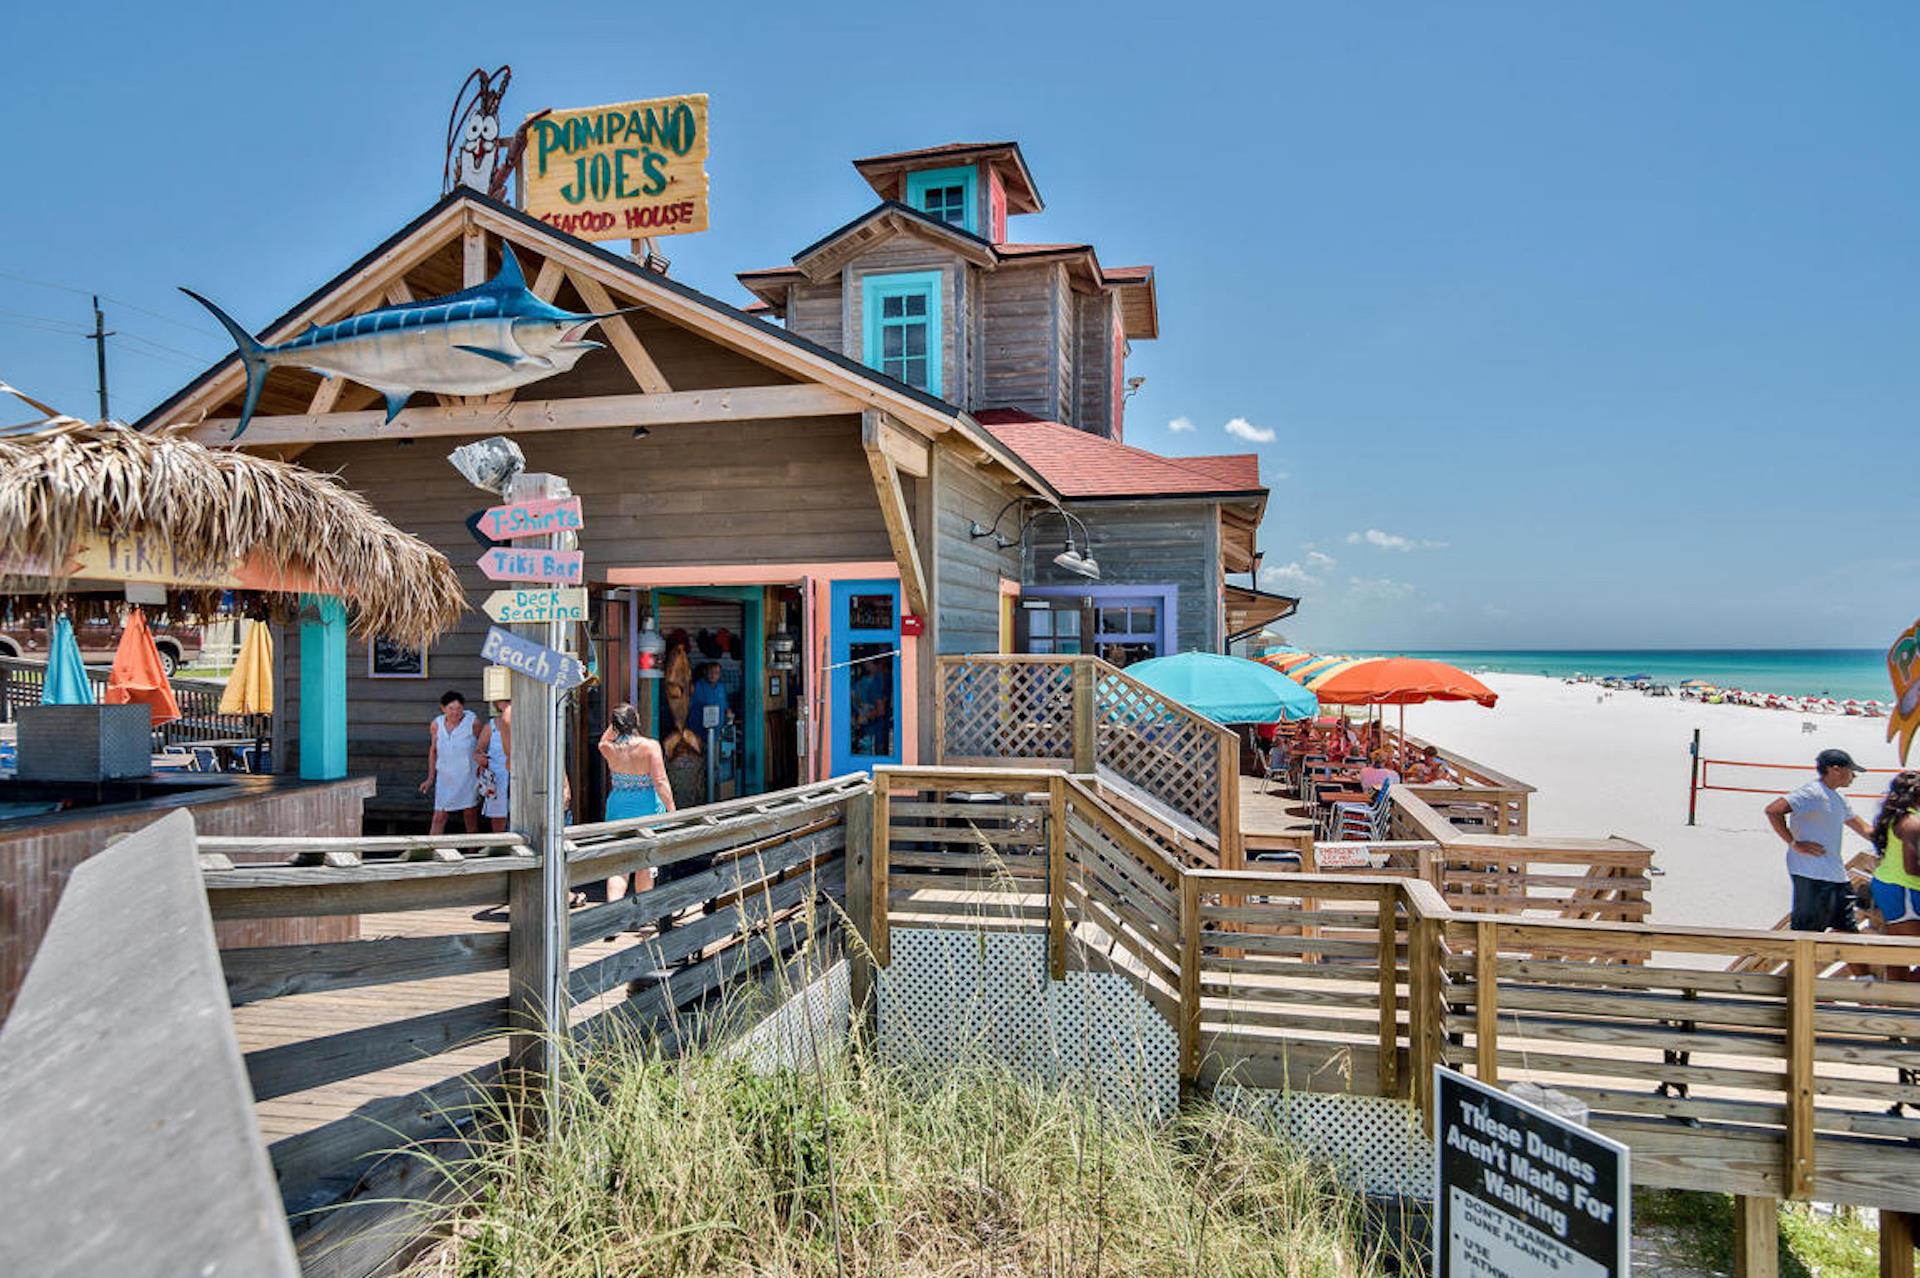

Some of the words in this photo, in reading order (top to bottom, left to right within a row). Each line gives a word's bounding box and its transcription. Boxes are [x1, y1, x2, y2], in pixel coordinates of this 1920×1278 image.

[533, 101, 696, 177] POMPANO
[560, 146, 668, 205] JOE'S
[624, 201, 695, 230] HOUSE
[488, 507, 580, 535] T-Shirts
[543, 555, 579, 577] Bar
[483, 630, 550, 678] Beach
[1459, 1100, 1523, 1149] These
[1527, 1130, 1597, 1185] Dunes
[1447, 1124, 1508, 1171] Aren't
[1511, 1152, 1569, 1202] Made
[1573, 1183, 1614, 1224] For
[1483, 1168, 1569, 1238] Walking
[1464, 1197, 1503, 1225] DON'T
[1508, 1219, 1574, 1265] TRAMPLE
[1464, 1210, 1501, 1238] DUNE
[1504, 1230, 1559, 1271] PLANTS
[1464, 1237, 1491, 1261] USE
